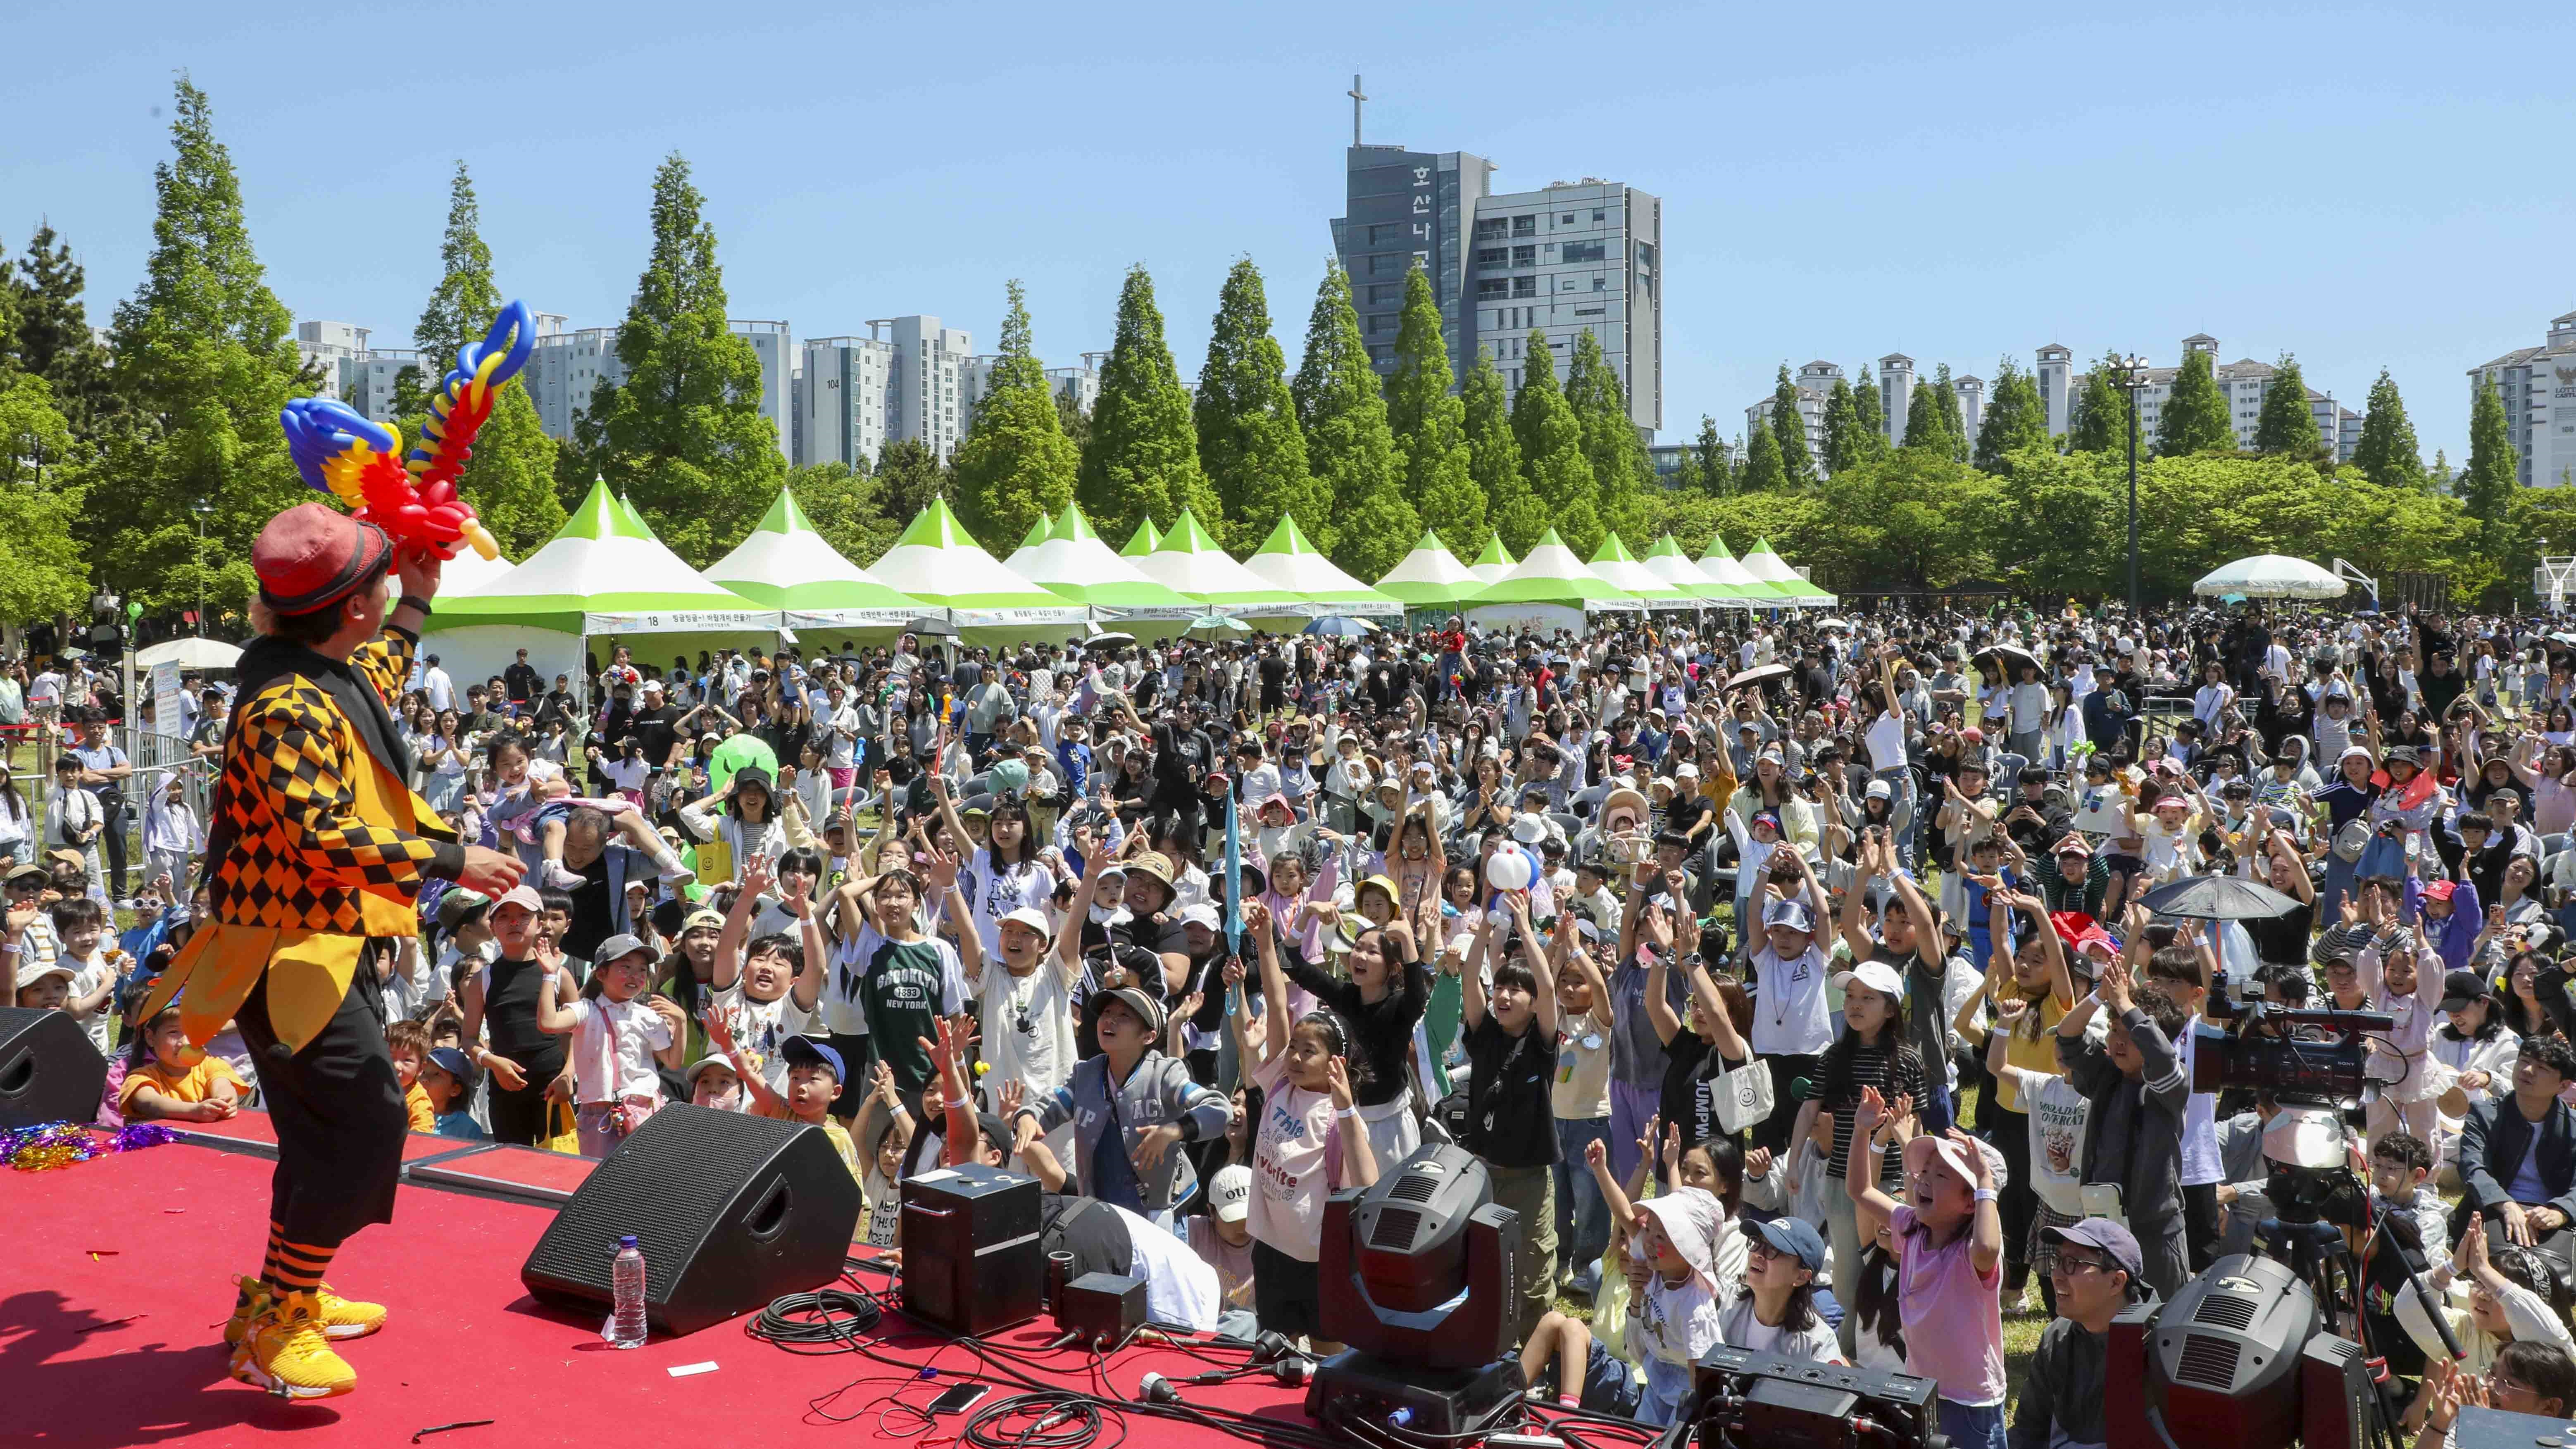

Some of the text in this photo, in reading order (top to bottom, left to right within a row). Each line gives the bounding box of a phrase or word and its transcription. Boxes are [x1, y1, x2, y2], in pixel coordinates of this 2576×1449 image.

[827, 379, 839, 390] 104
[648, 616, 658, 626] 18
[835, 614, 844, 622] 17
[995, 612, 1004, 621] 16
[876, 967, 939, 997] BROOKLYN
[886, 999, 928, 1010] NEW YORK
[1329, 1015, 1346, 1040] Bonjour
[1272, 1106, 1305, 1138] This
